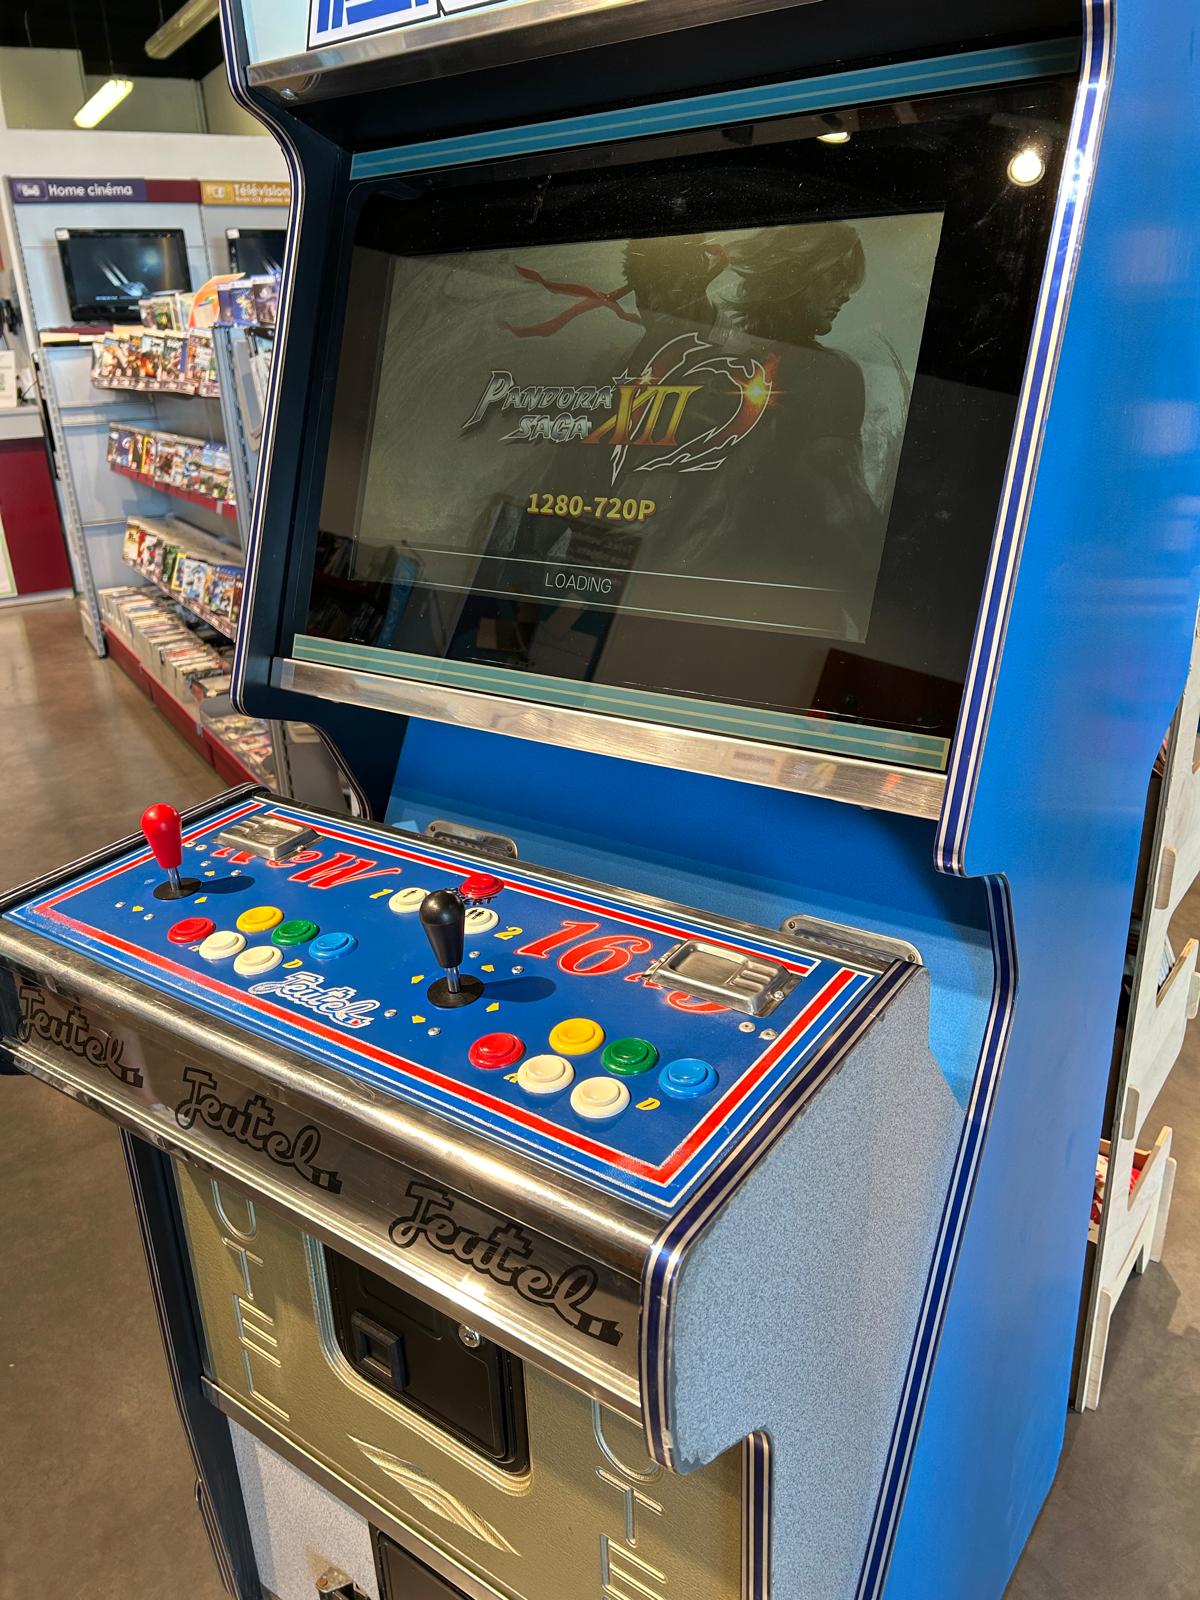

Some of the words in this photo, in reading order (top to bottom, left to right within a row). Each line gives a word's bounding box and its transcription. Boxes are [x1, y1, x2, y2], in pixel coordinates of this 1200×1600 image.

[48, 184, 85, 197] Home
[87, 182, 133, 197] cinéma
[461, 370, 613, 430] PANDORA
[499, 412, 592, 443] SAGA
[526, 493, 657, 522] 1280-720P
[544, 572, 613, 595] LOADING
[493, 926, 524, 941] 2
[247, 970, 381, 1029] Jeutel
[16, 985, 144, 1089] Jeutel
[635, 1097, 661, 1111] D
[175, 1066, 343, 1195] Jeutel
[389, 1181, 625, 1348] Jeutel
